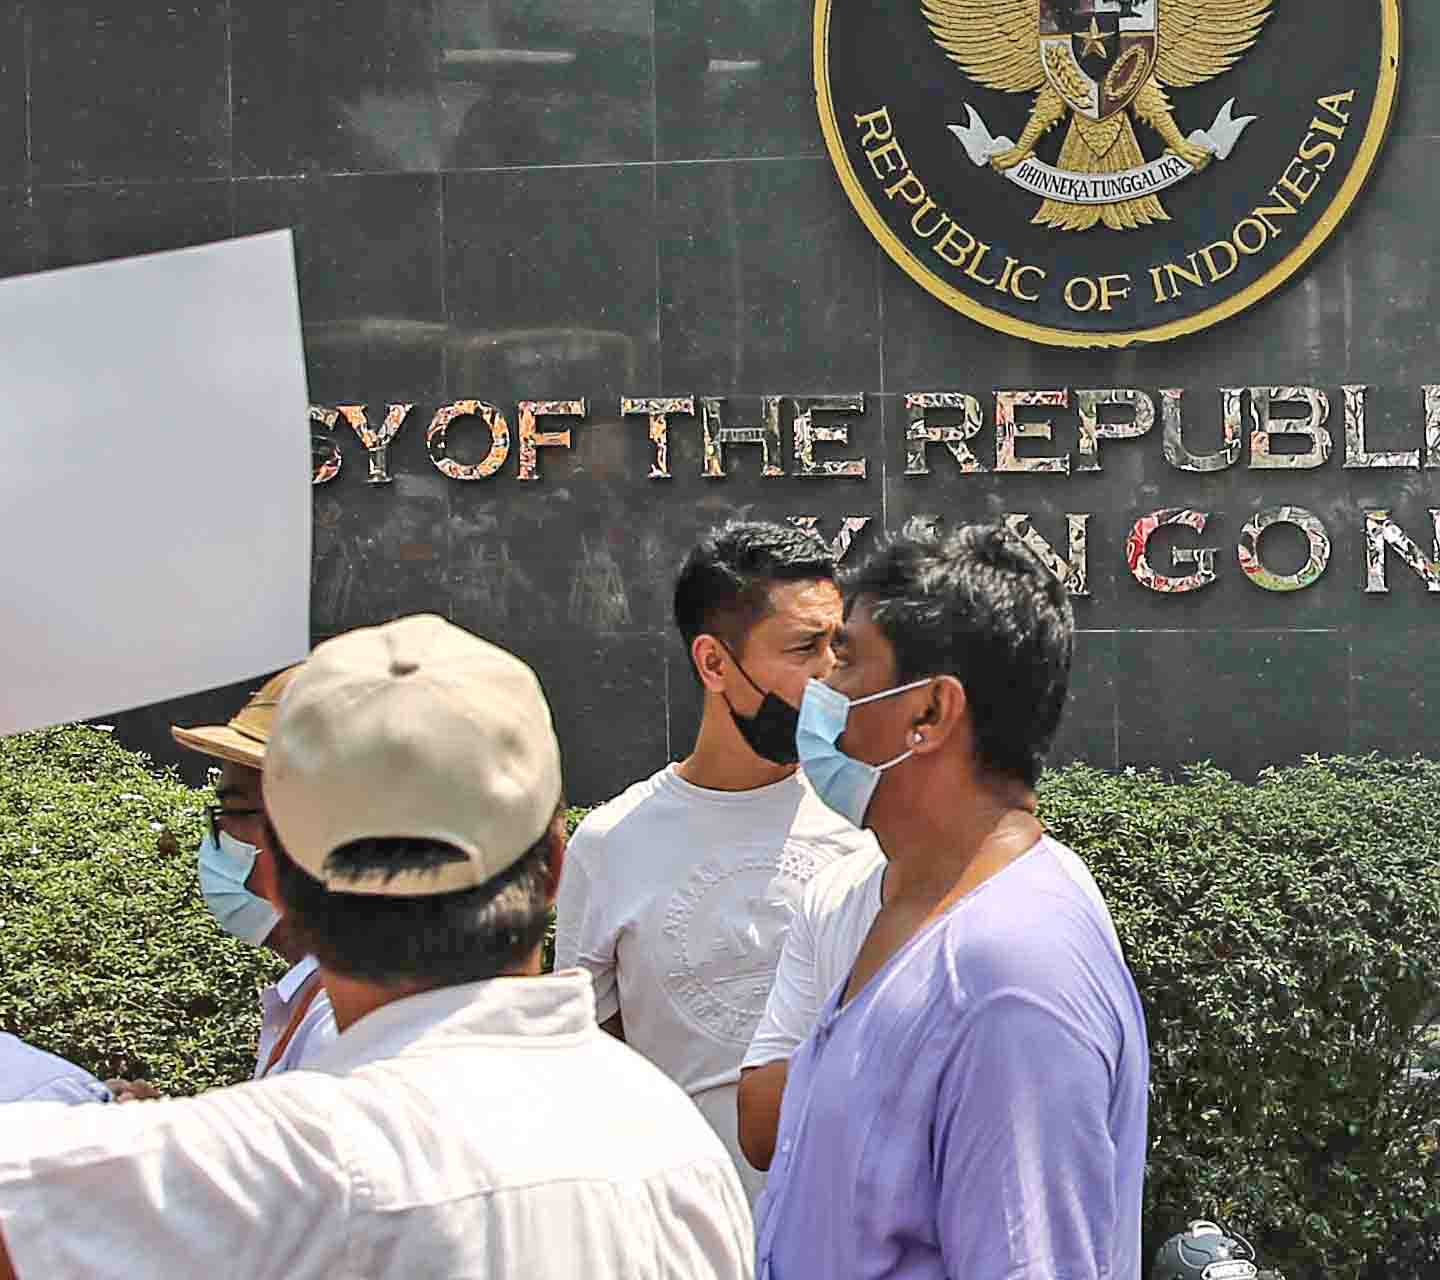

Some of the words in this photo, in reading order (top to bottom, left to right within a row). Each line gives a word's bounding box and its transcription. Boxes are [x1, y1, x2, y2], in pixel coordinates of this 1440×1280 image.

[853, 104, 1048, 303] REPUBLIC
[1063, 273, 1132, 313] OF
[1148, 87, 1356, 304] INDONESIA
[1016, 162, 1091, 202] BHINNEKA
[1090, 169, 1160, 199] TUNGGAL
[1160, 156, 1187, 180] IKA
[425, 397, 591, 481] OF
[620, 392, 871, 480] THE
